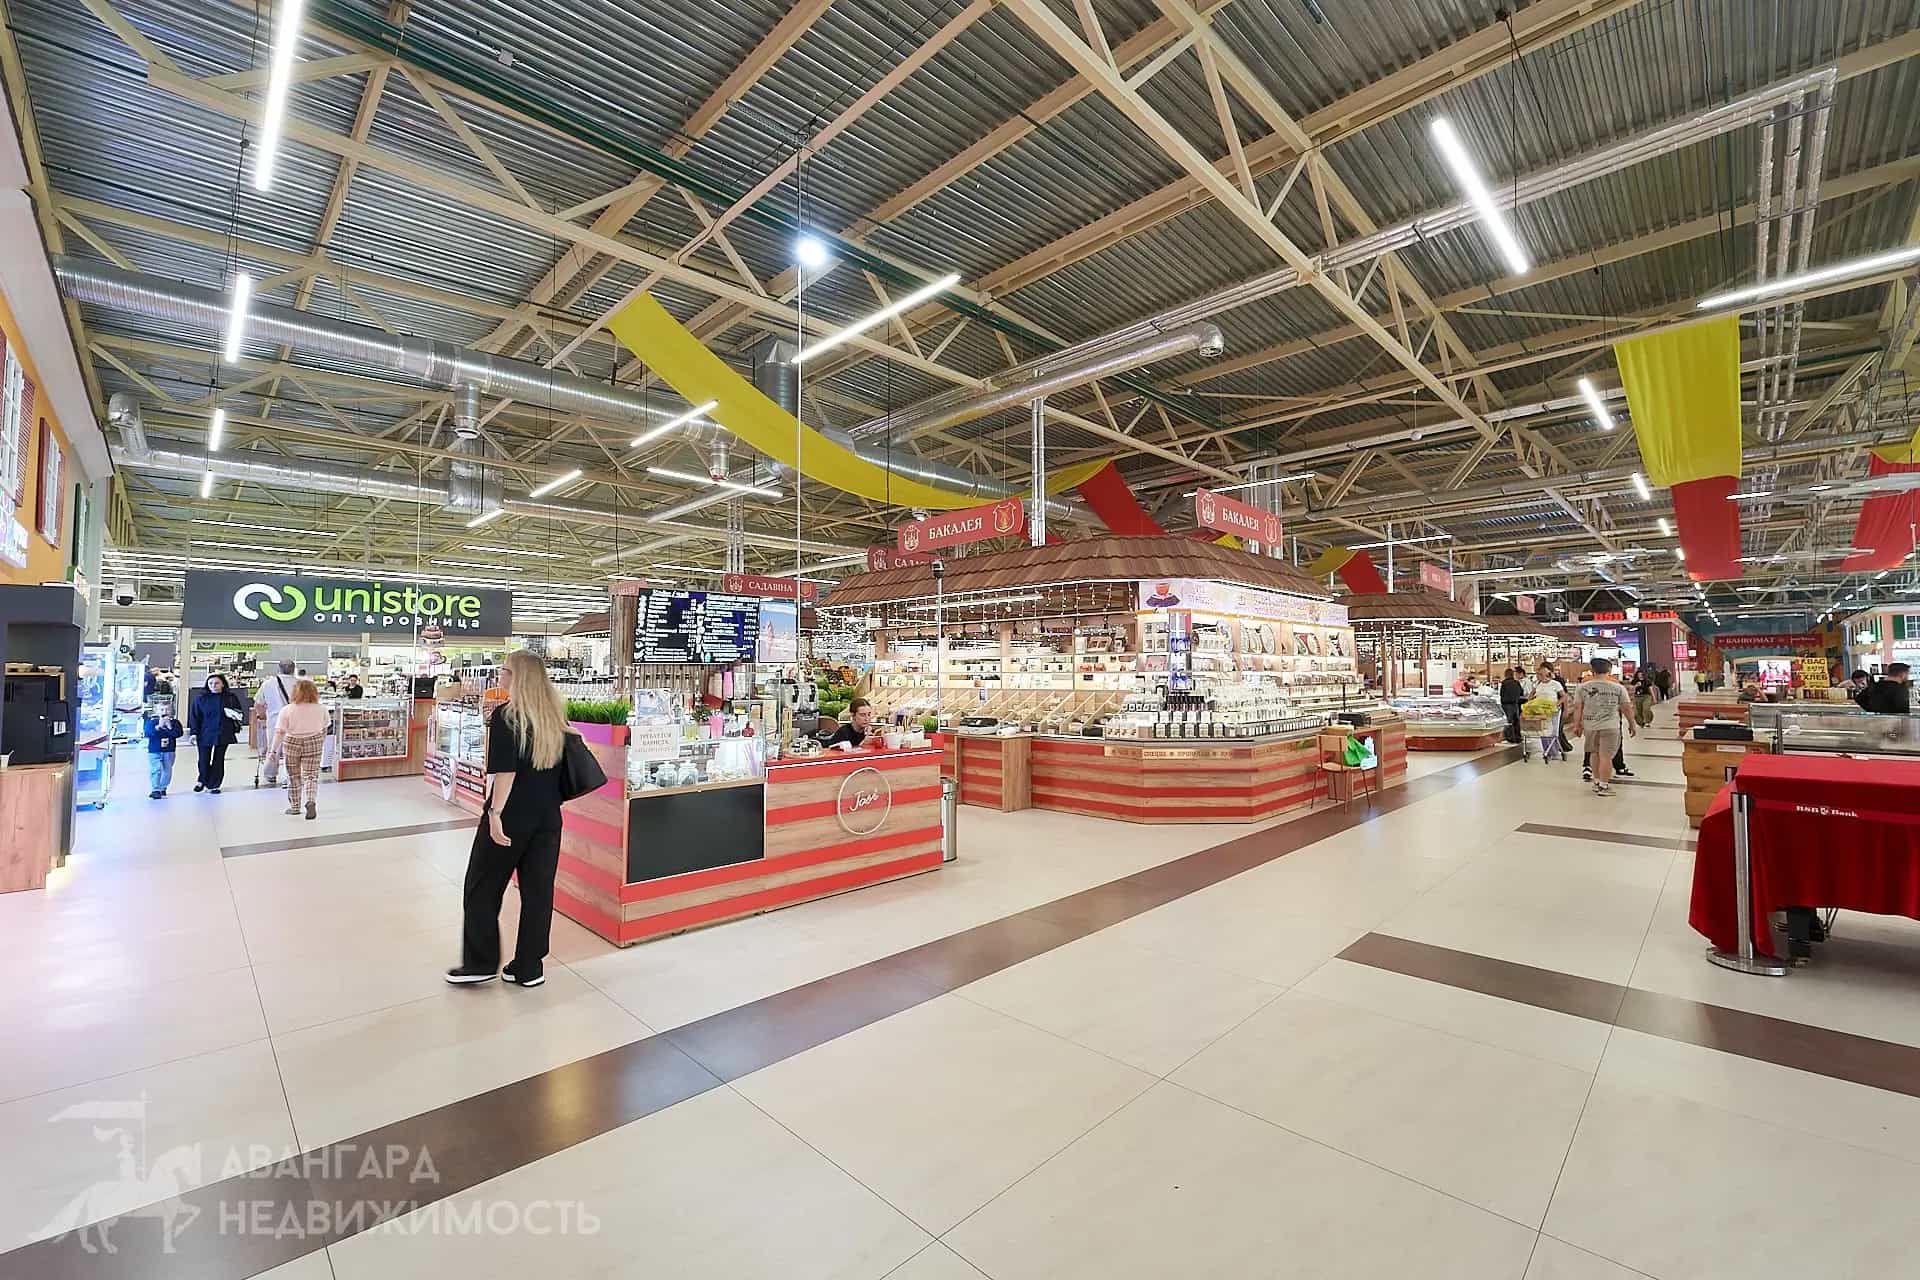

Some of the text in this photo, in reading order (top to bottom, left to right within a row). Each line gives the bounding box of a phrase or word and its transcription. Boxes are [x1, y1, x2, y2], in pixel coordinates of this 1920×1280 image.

[1222, 507, 1260, 531] БАКАЛЕЯ
[929, 518, 983, 540] БАКАЛЕЯ
[748, 581, 793, 592] САДАВІНА
[314, 583, 481, 617] unistore
[313, 612, 480, 629] опт & розница
[1640, 609, 1681, 619] Bank
[1831, 809, 1859, 817] Bank
